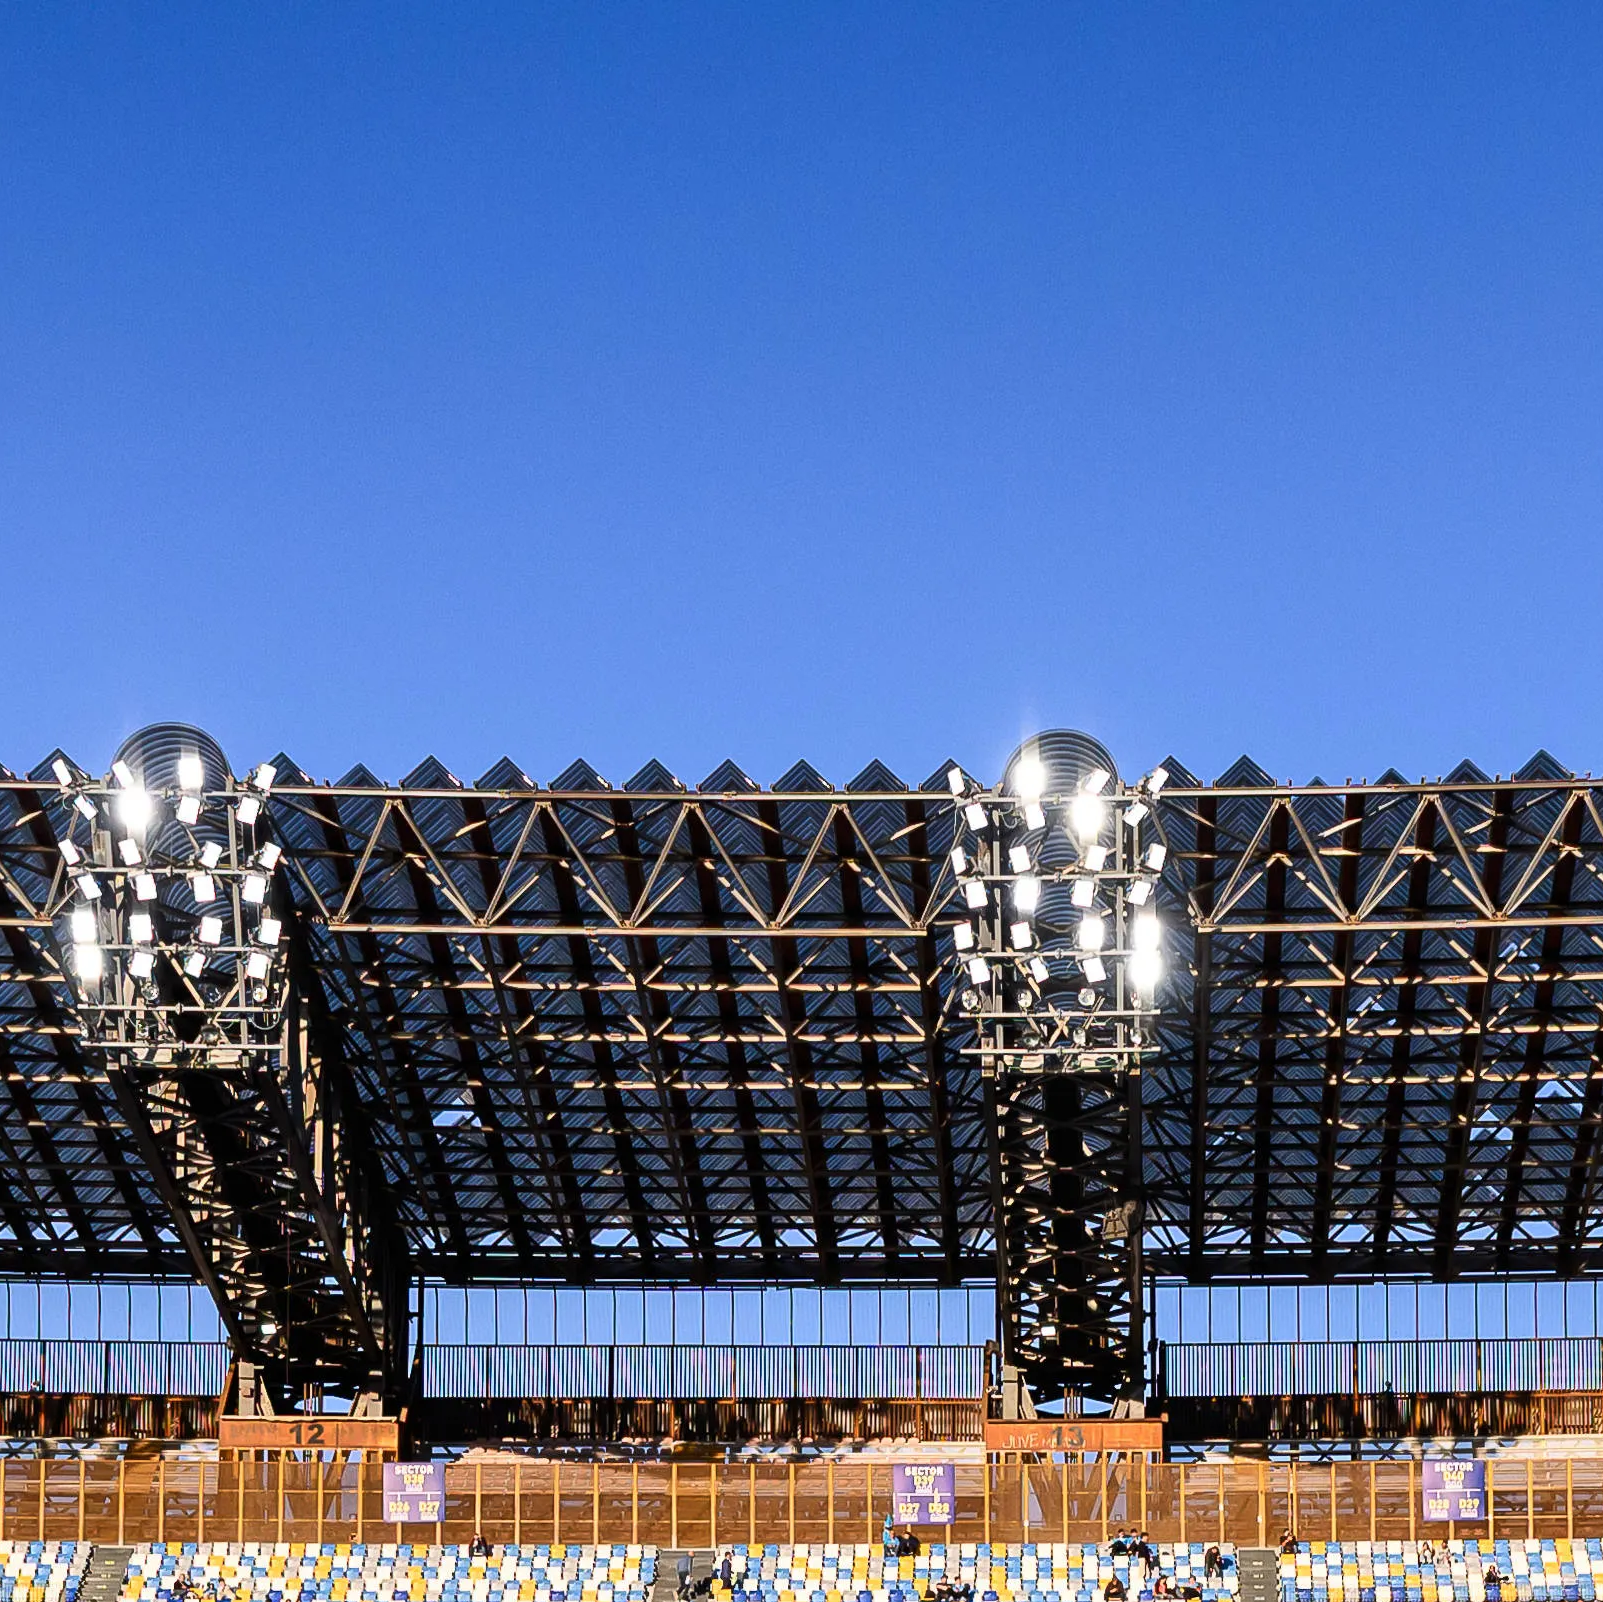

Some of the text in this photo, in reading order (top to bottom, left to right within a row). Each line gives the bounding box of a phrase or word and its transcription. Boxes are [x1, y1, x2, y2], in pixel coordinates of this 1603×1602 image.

[289, 1423, 325, 1444] 12
[1052, 1426, 1085, 1447] 13
[1002, 1433, 1039, 1449] JUVE
[394, 1464, 434, 1475] SECTOR
[904, 1466, 944, 1477] SECTOR
[1434, 1462, 1473, 1472] SECTOR
